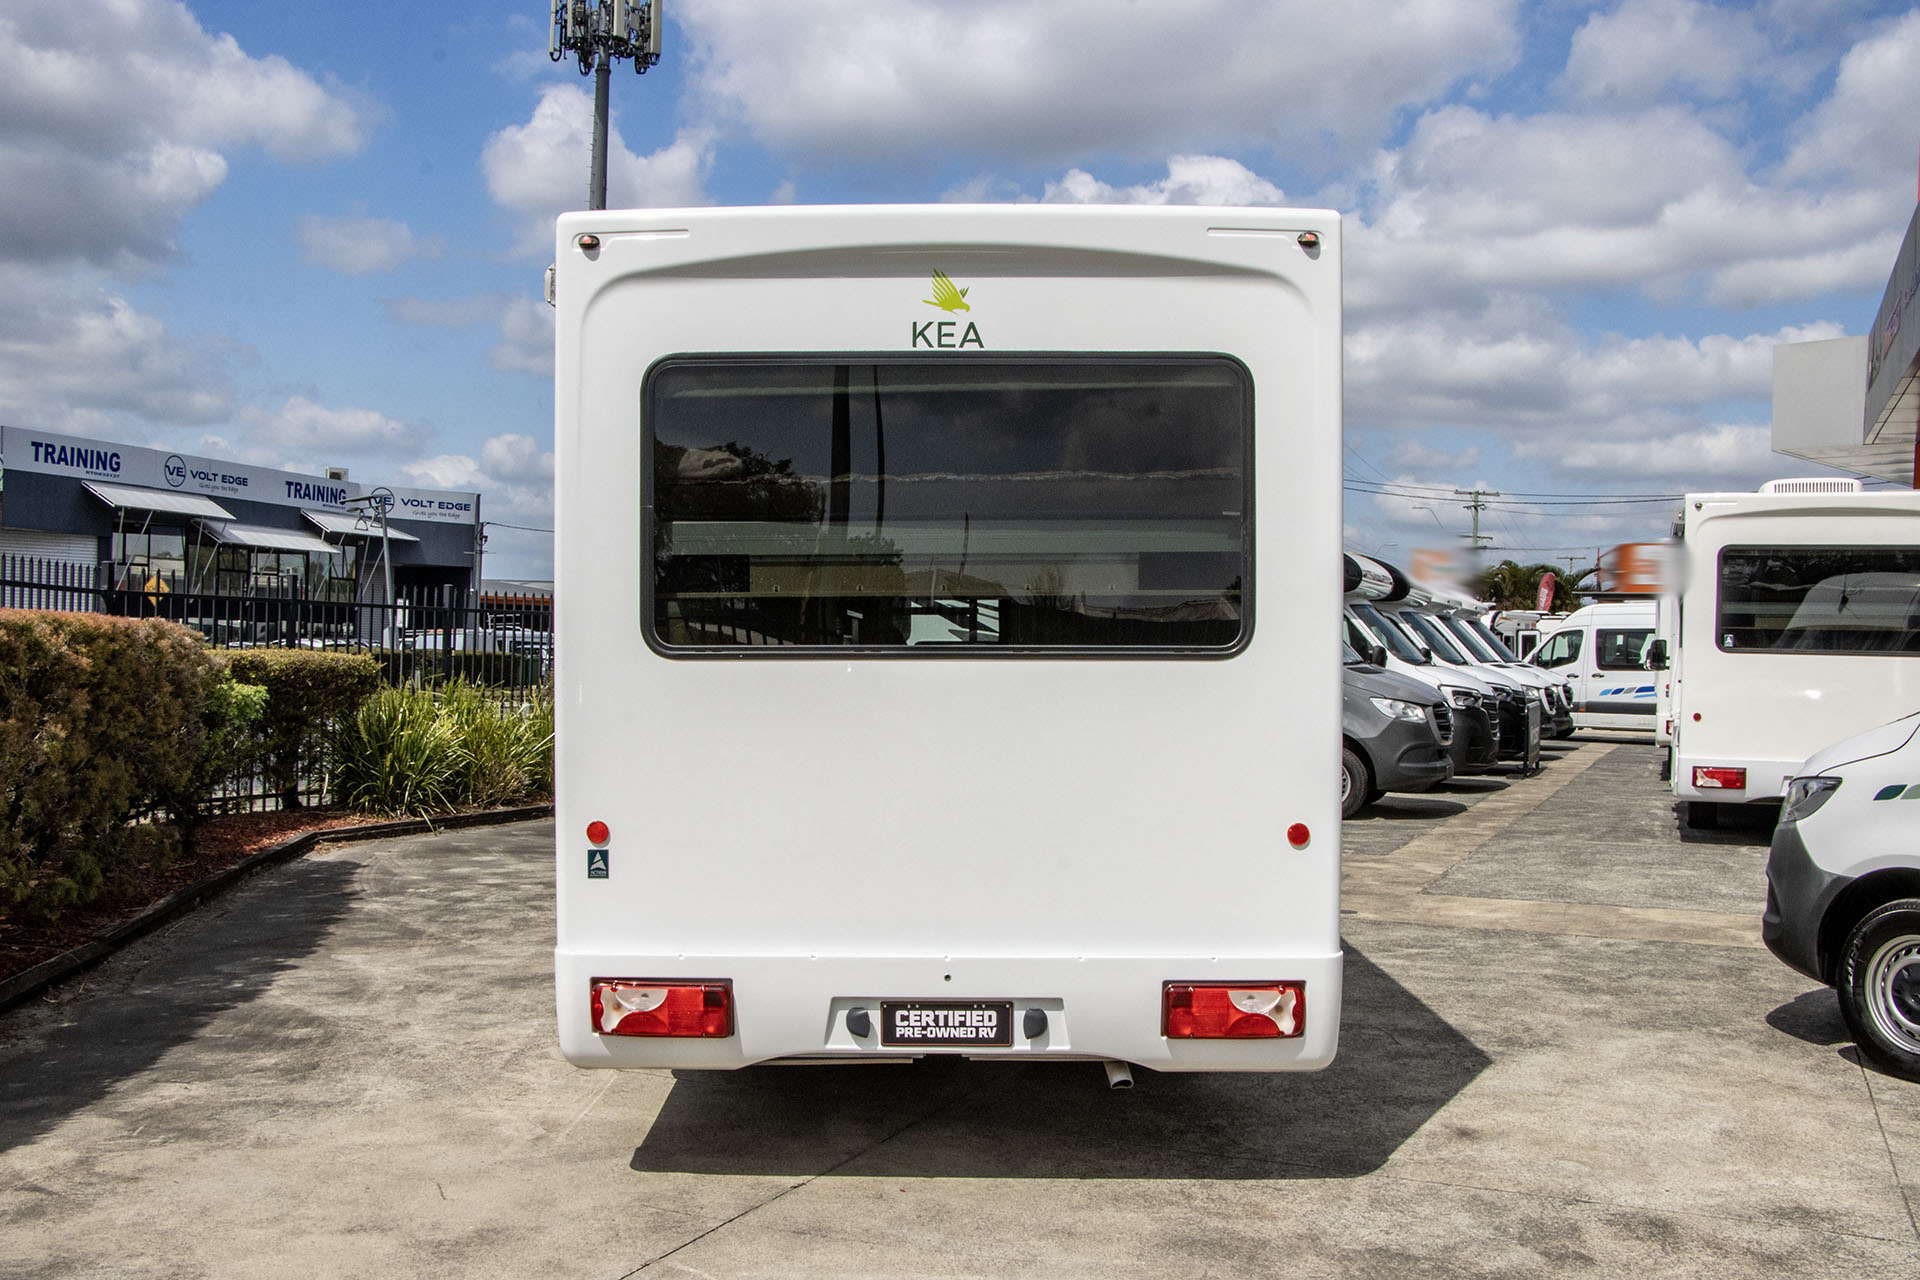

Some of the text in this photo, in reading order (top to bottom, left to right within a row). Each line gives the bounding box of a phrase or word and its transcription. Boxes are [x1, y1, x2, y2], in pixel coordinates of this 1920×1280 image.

[912, 321, 985, 348] KEA
[31, 441, 121, 472] TRAINING
[190, 469, 248, 487] VOLT EDGE
[285, 480, 347, 506] TRAINING
[401, 498, 472, 512] VOLT EDGE
[895, 1010, 997, 1027] CERTIFIED
[895, 1027, 997, 1038] PRE-OWNED RV
